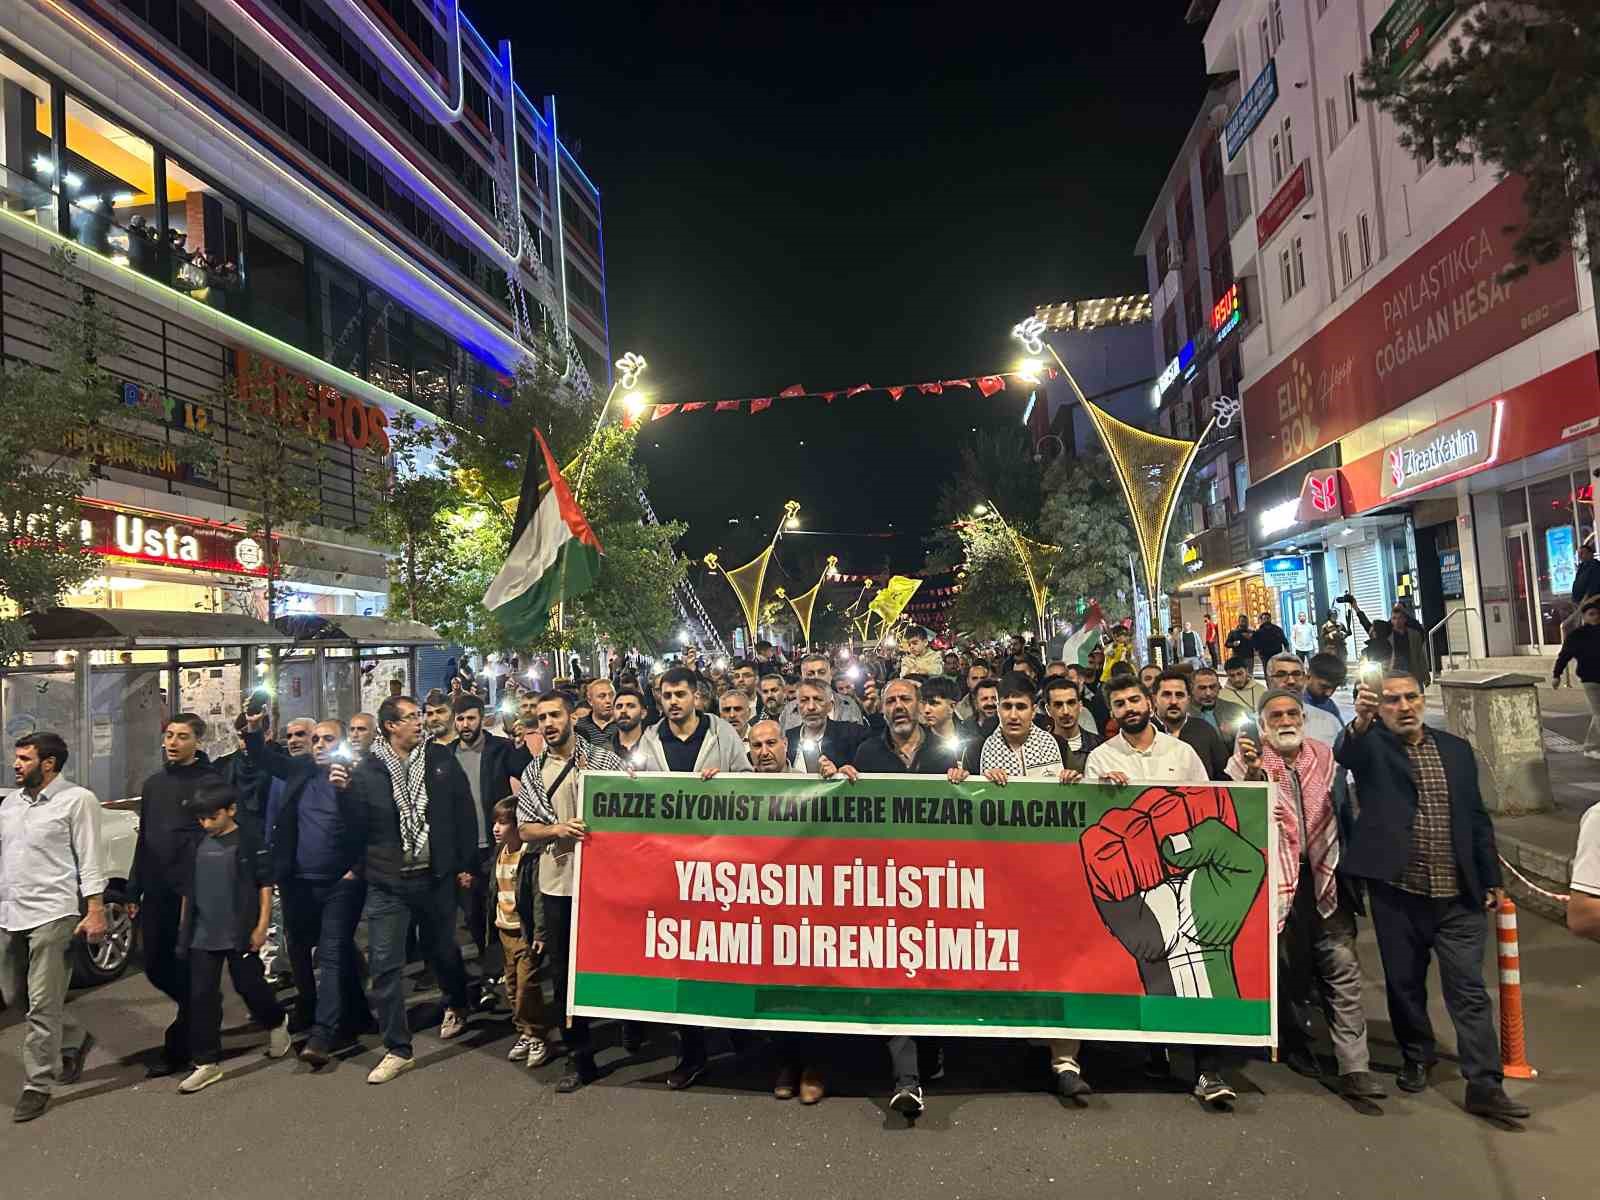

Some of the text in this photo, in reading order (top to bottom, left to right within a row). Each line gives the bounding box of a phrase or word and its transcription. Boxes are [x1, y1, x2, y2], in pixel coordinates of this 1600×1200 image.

[1383, 227, 1494, 331] PAYLAŞTIKÇA
[1375, 304, 1450, 379] ÇOĞALAN
[115, 513, 201, 562] Usta
[592, 791, 656, 819] GAZZE
[660, 789, 764, 822] SİYONİST
[892, 797, 974, 826] MEZAR
[980, 799, 1086, 828] OLACAK!
[674, 857, 985, 911] YAŞASIN FİLİSTİN
[645, 910, 1020, 978] İSLAMİ DİRENİŞİMİZ!
